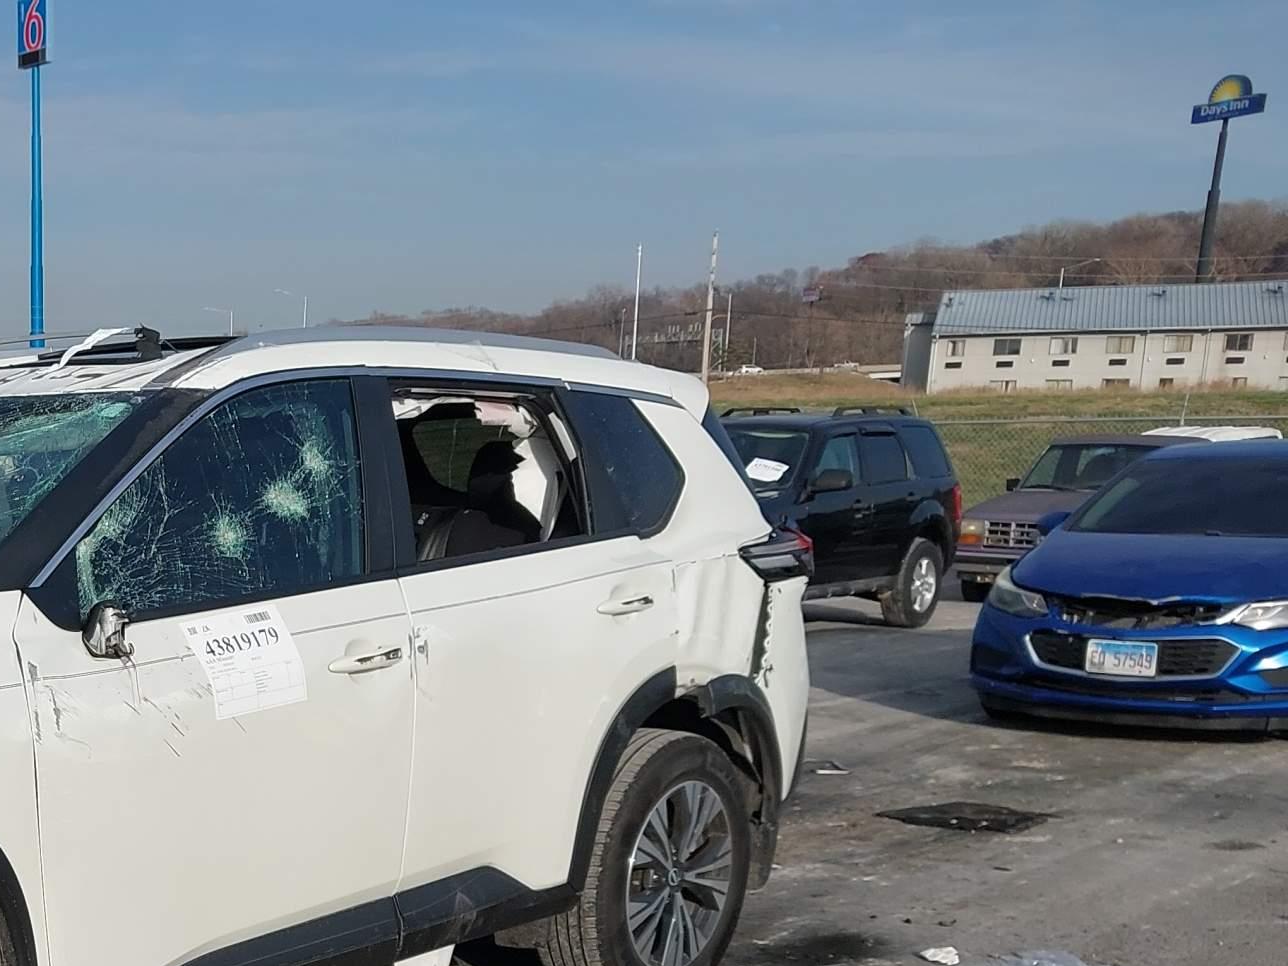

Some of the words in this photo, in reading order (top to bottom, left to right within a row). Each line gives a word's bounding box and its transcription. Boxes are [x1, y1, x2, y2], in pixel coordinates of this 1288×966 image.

[23, 0, 43, 51] 6
[1201, 102, 1228, 116] Days
[1230, 99, 1249, 111] Inn
[205, 626, 279, 656] 43819179
[1112, 652, 1152, 670] 57549
